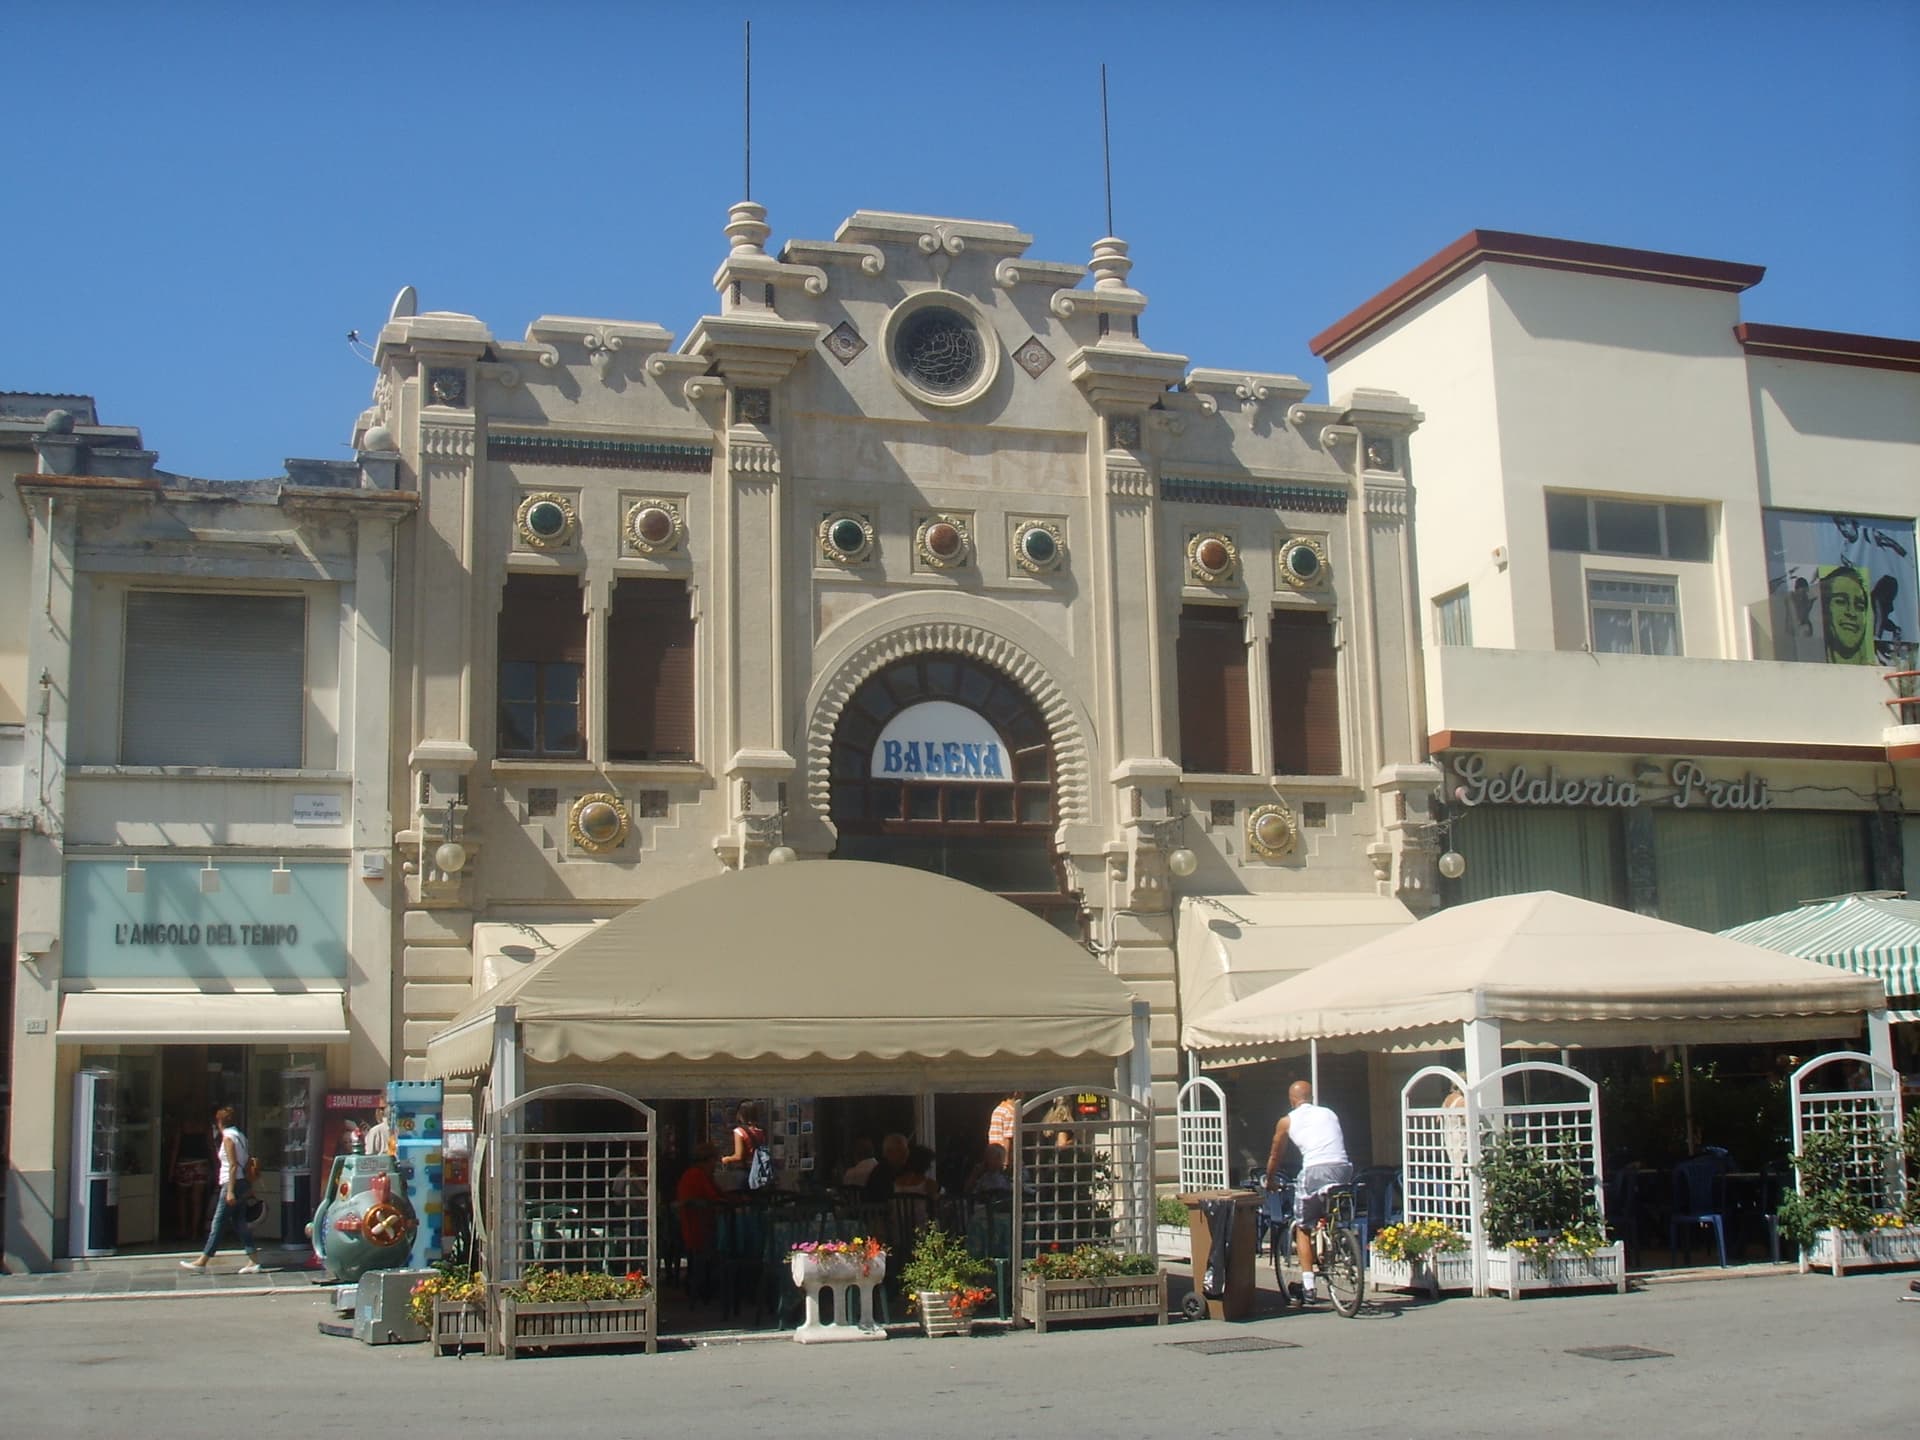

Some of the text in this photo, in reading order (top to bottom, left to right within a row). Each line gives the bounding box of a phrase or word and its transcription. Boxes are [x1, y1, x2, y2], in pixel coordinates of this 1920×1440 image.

[883, 739, 1003, 777] BALENA
[1454, 755, 1774, 810] Gelateria Prati
[115, 923, 298, 946] L'ANGOLO DEL TEMPO
